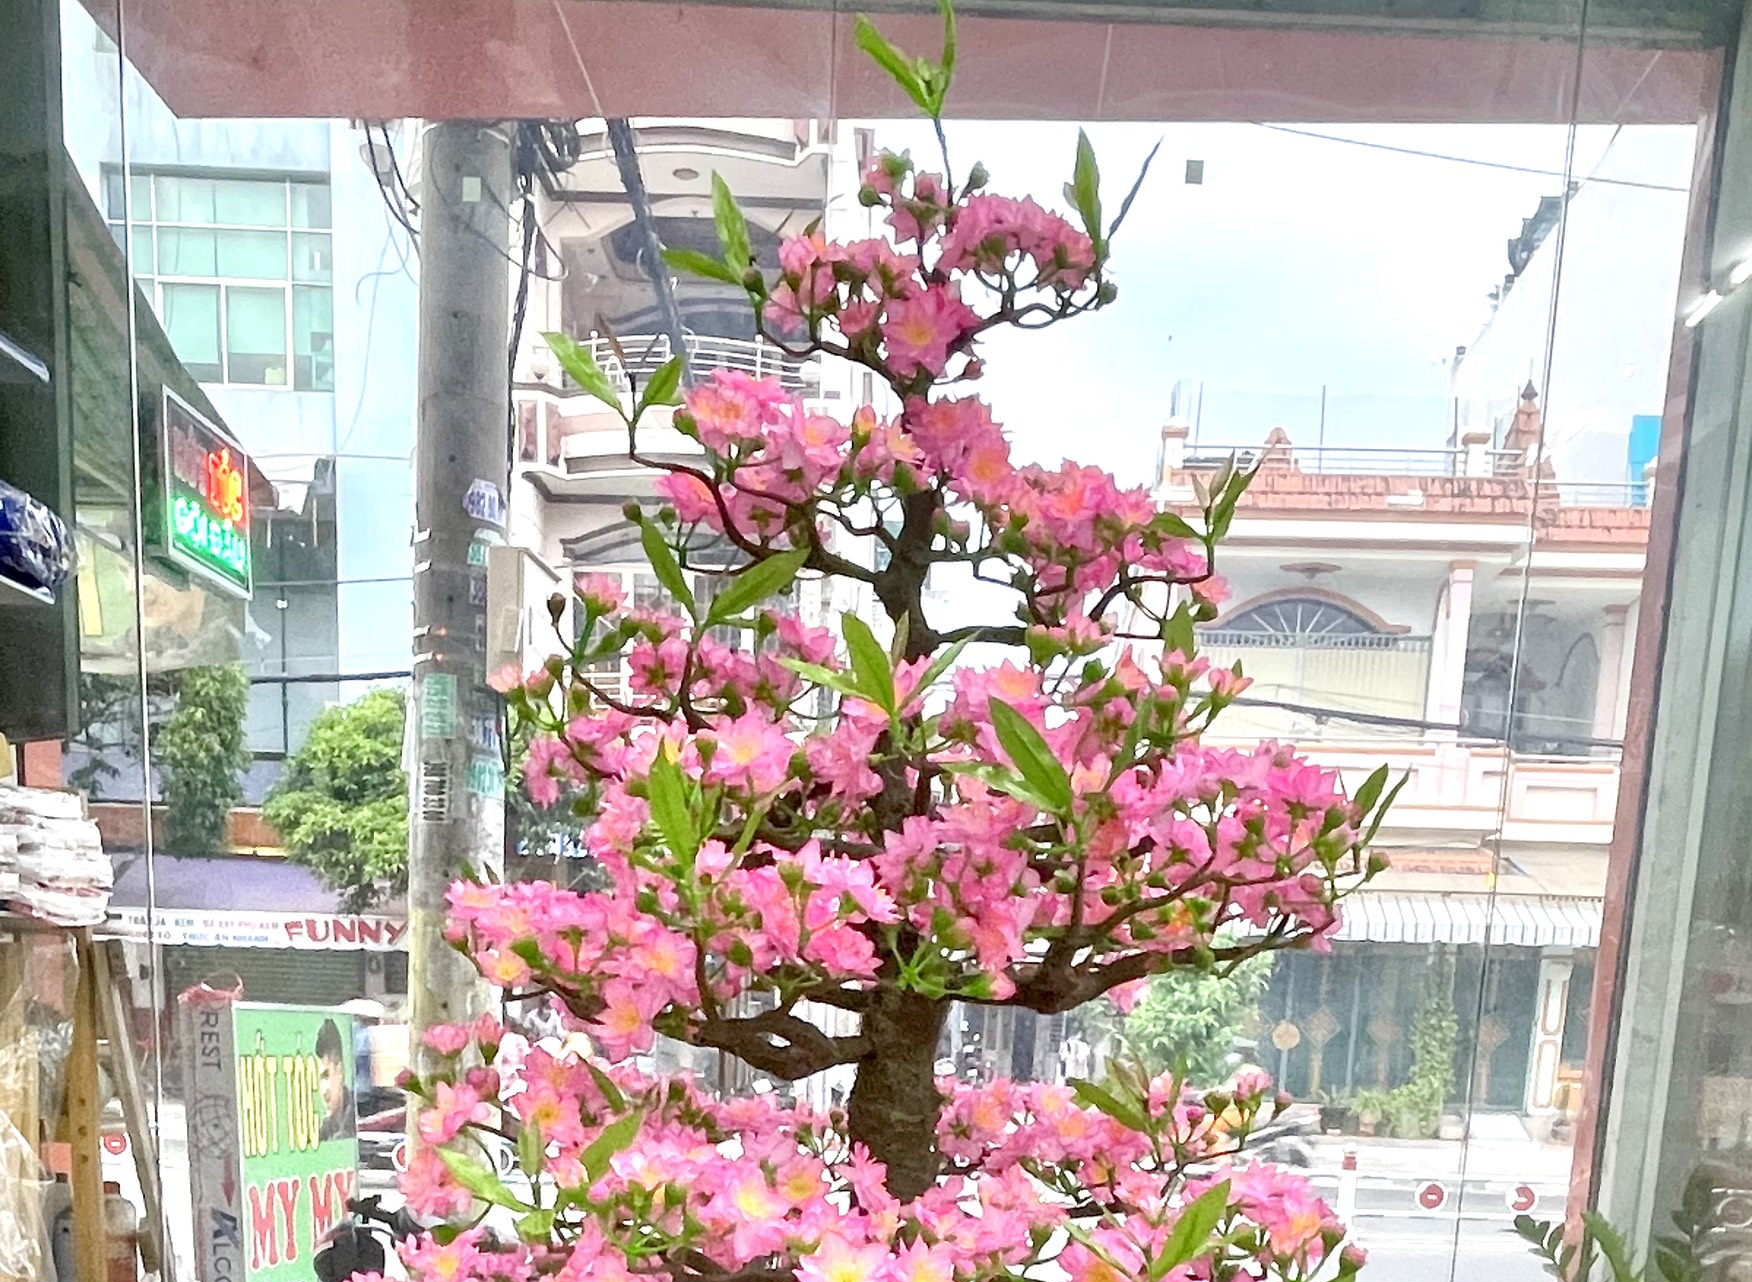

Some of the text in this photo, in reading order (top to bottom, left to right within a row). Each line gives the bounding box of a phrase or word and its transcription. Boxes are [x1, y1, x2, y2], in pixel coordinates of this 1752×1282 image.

[284, 918, 408, 945] FUNNY
[283, 1031, 320, 1153] TÓC
[249, 1179, 300, 1270] MY
